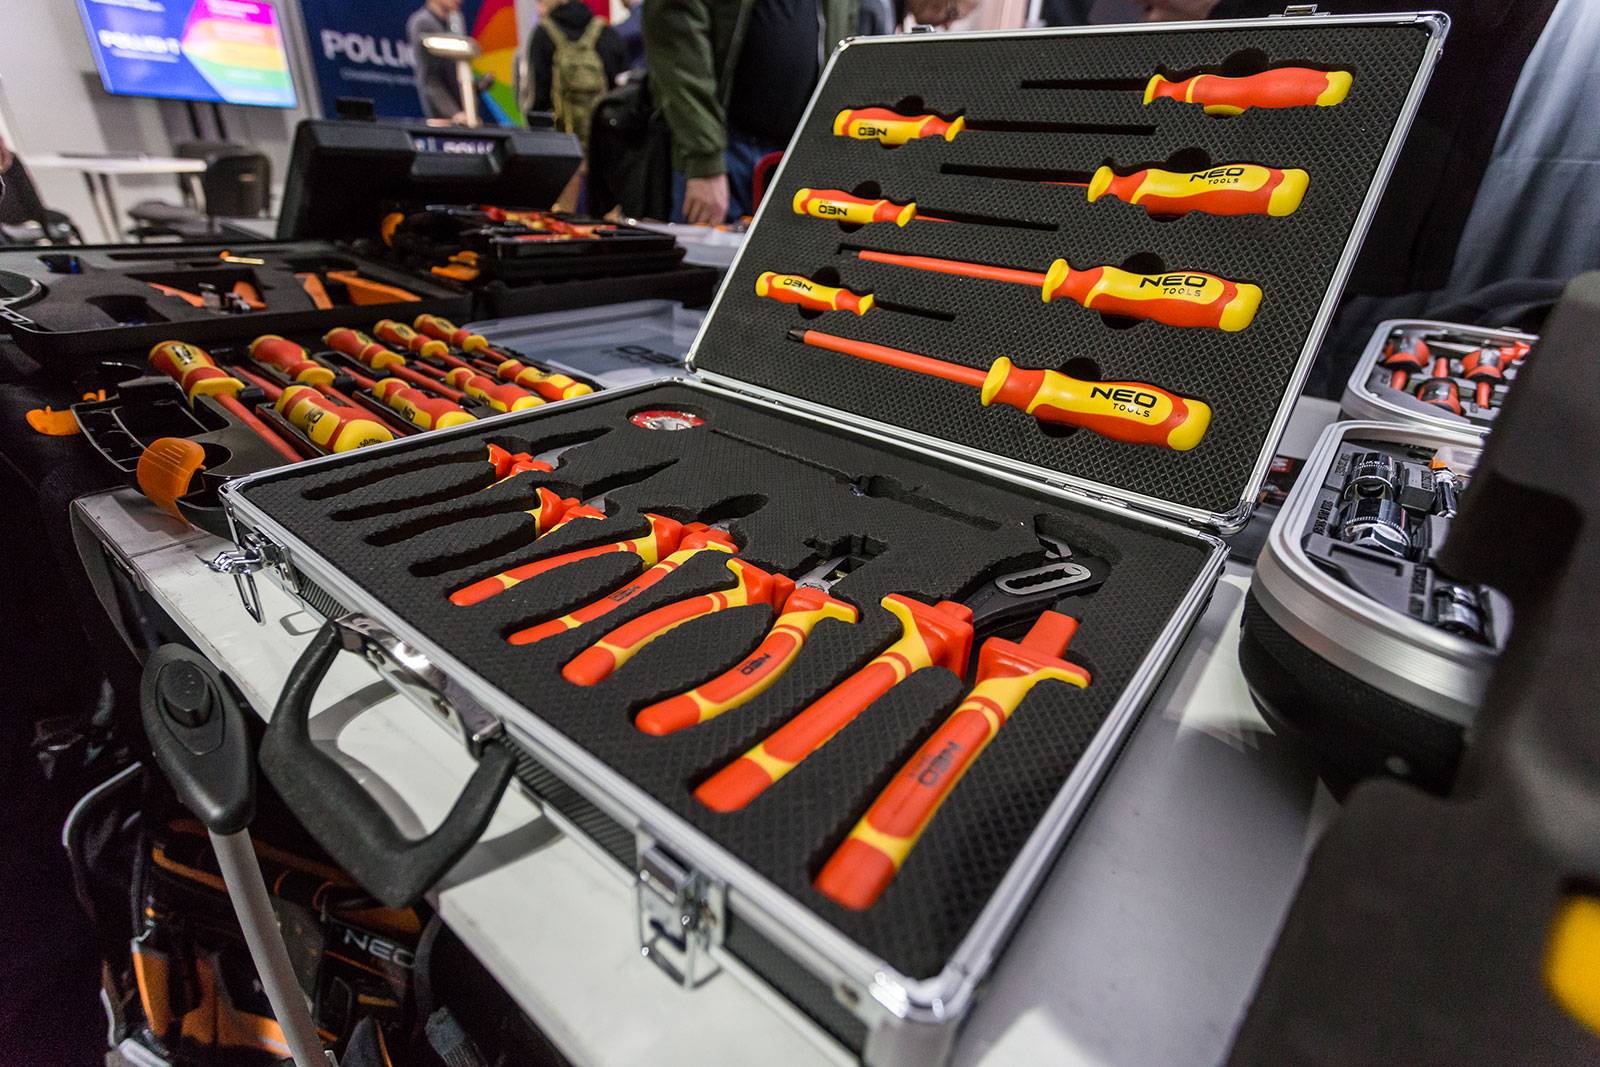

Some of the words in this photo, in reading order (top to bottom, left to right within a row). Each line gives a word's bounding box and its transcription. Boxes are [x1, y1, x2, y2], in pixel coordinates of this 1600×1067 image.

[858, 127, 887, 136] NEO
[1189, 167, 1245, 182] NEO
[818, 204, 848, 216] NEO
[783, 277, 813, 292] NEO
[1139, 274, 1208, 288] NEO
[1163, 287, 1202, 297] TOOLS
[1090, 386, 1158, 409] NEO
[1113, 402, 1151, 418] TOOLS
[740, 652, 772, 676] NEO
[917, 741, 963, 787] NEO
[343, 927, 416, 969] NEO
